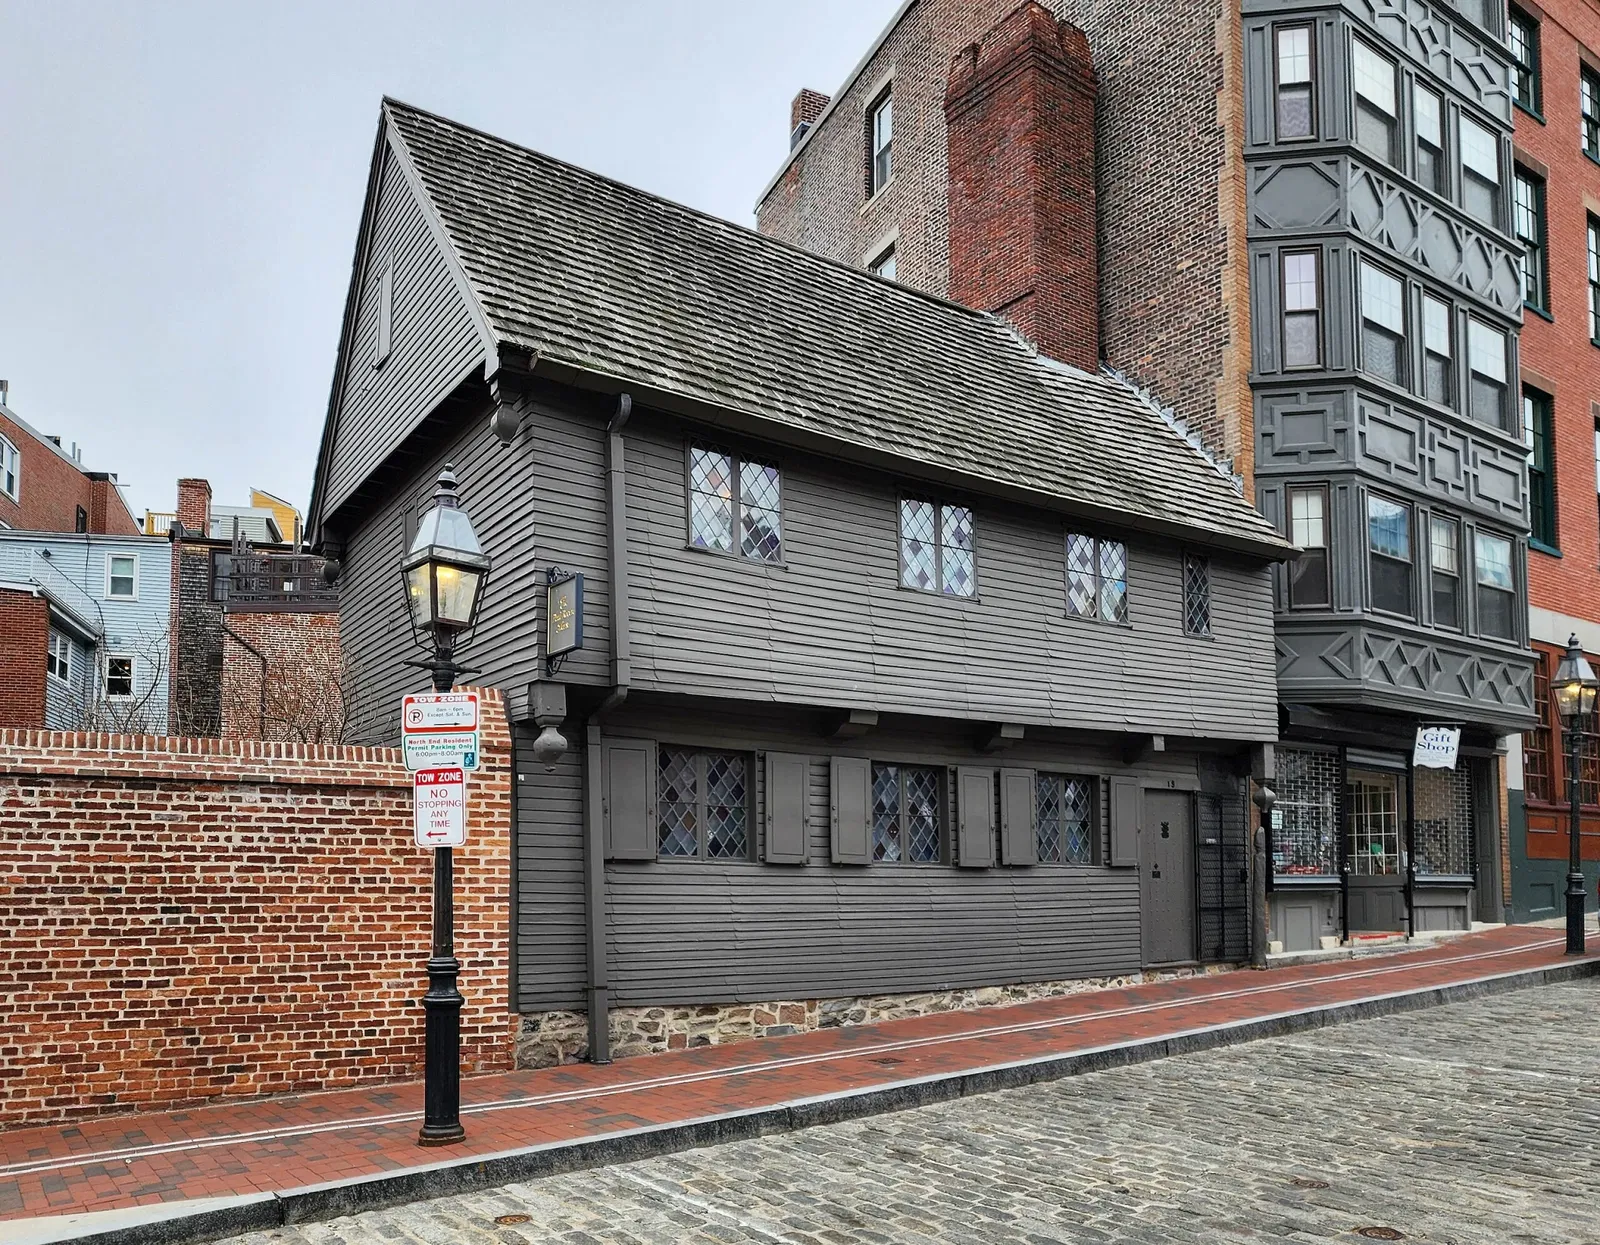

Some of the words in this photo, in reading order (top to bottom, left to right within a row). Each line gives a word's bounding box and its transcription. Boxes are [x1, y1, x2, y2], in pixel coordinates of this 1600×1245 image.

[1423, 732, 1451, 742] Gift
[1416, 742, 1455, 753] Shop
[417, 772, 435, 783] TOW
[438, 771, 462, 782] ZONE
[430, 788, 449, 798] NO
[418, 799, 462, 809] STOPPING
[430, 810, 448, 818] ANY
[429, 820, 451, 828] TIME
